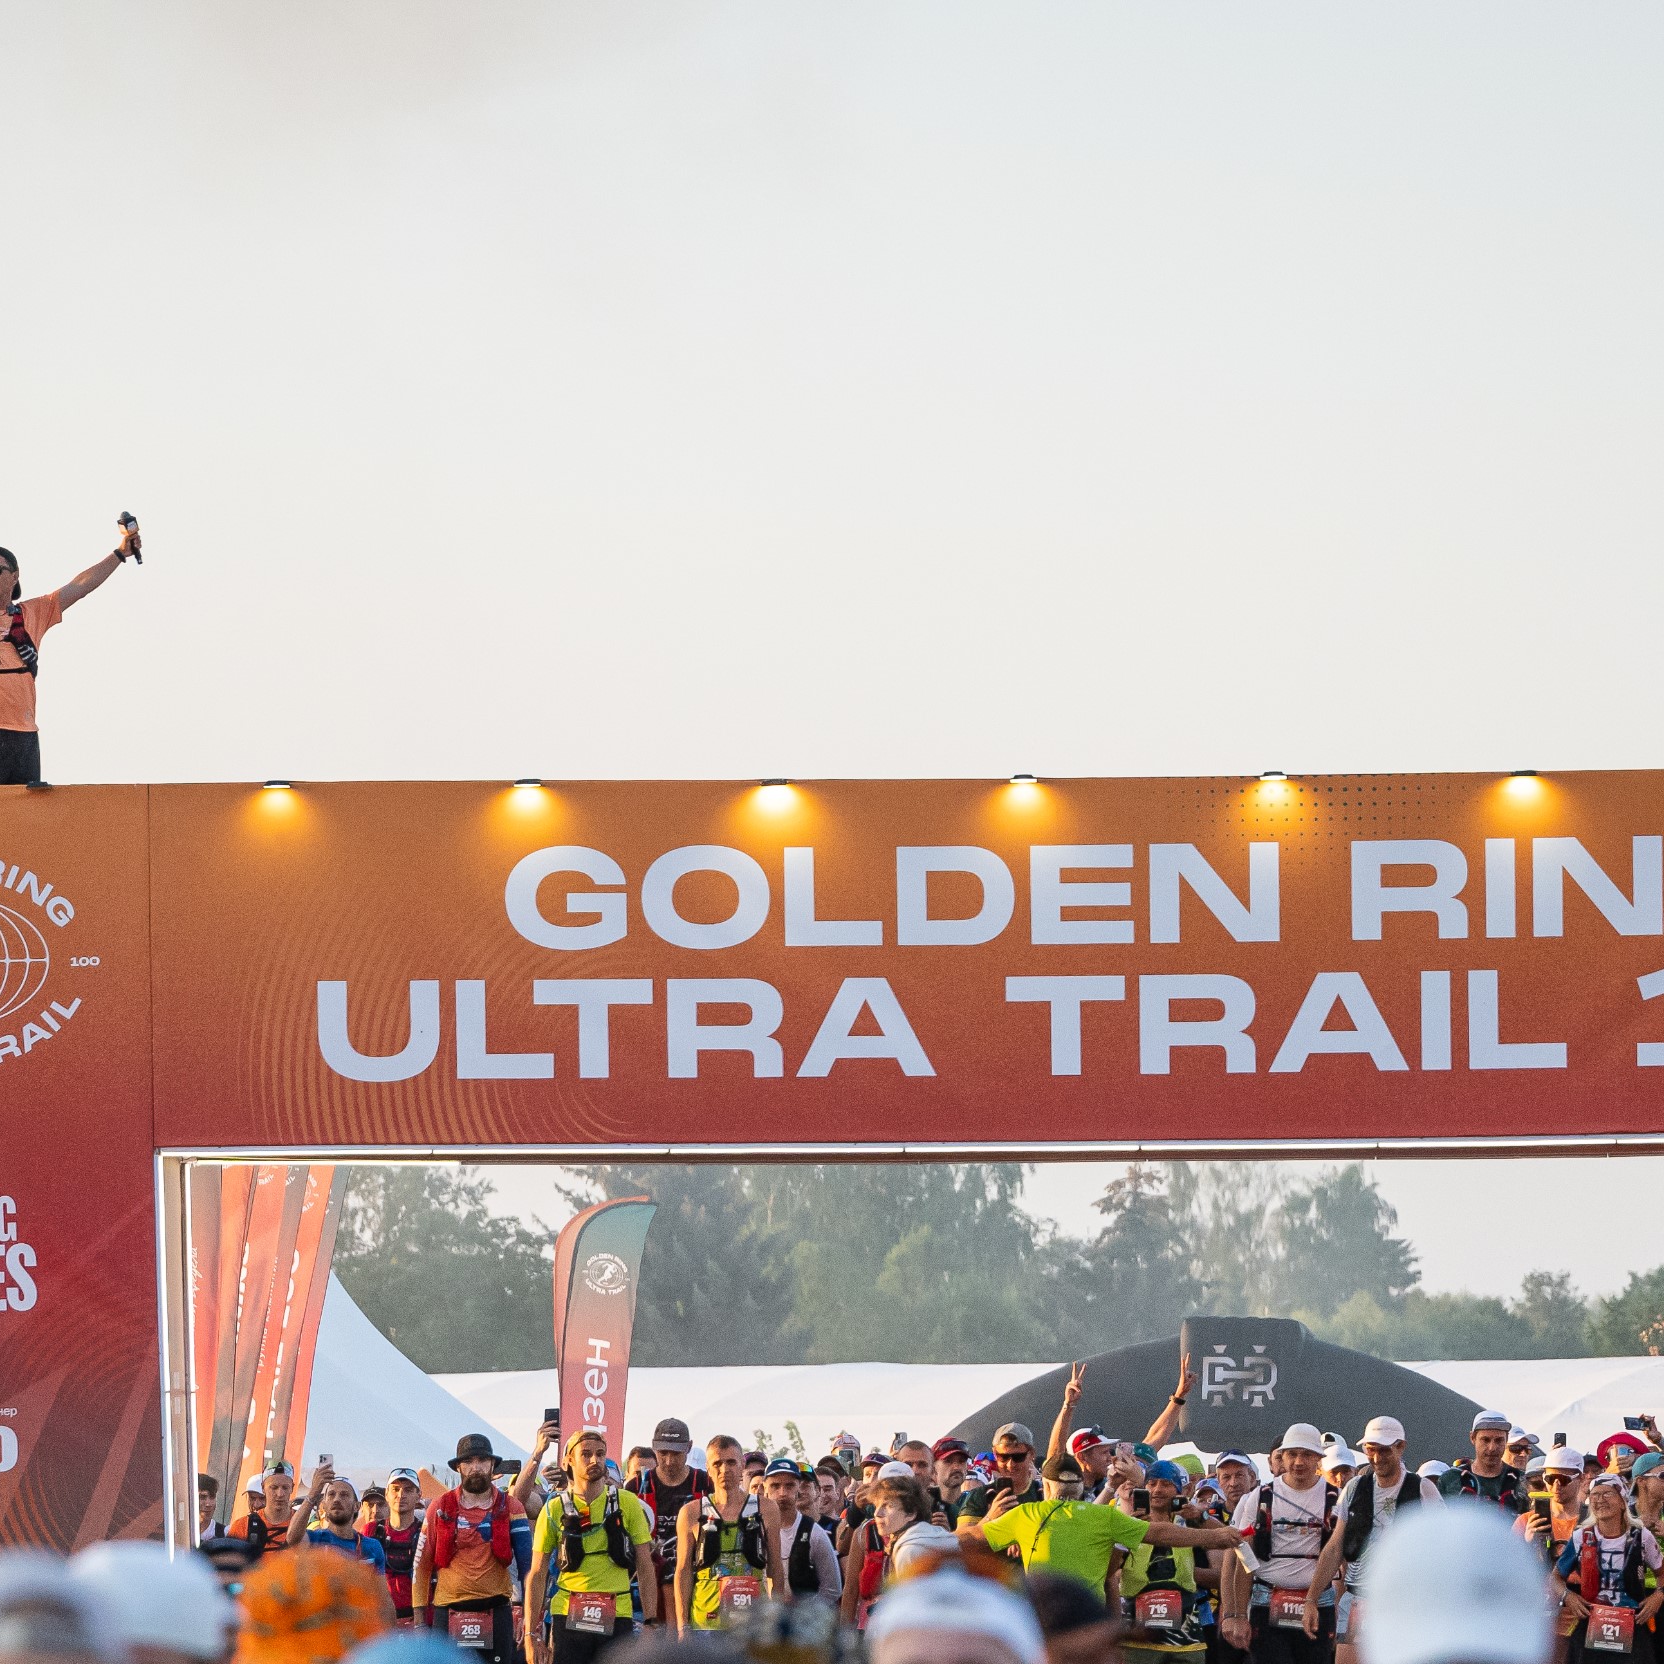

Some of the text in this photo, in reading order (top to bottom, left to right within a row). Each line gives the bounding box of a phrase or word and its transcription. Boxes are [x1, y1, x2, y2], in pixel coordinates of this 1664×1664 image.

[504, 842, 1280, 951] GOLDEN
[70, 956, 100, 967] 100
[317, 977, 937, 1083] ULTRA
[1005, 968, 1567, 1076] TRAIL
[733, 1594, 752, 1606] 591
[582, 1606, 602, 1618] 146
[1149, 1604, 1168, 1615] 716
[461, 1624, 481, 1635] 268
[1601, 1623, 1620, 1637] 121
